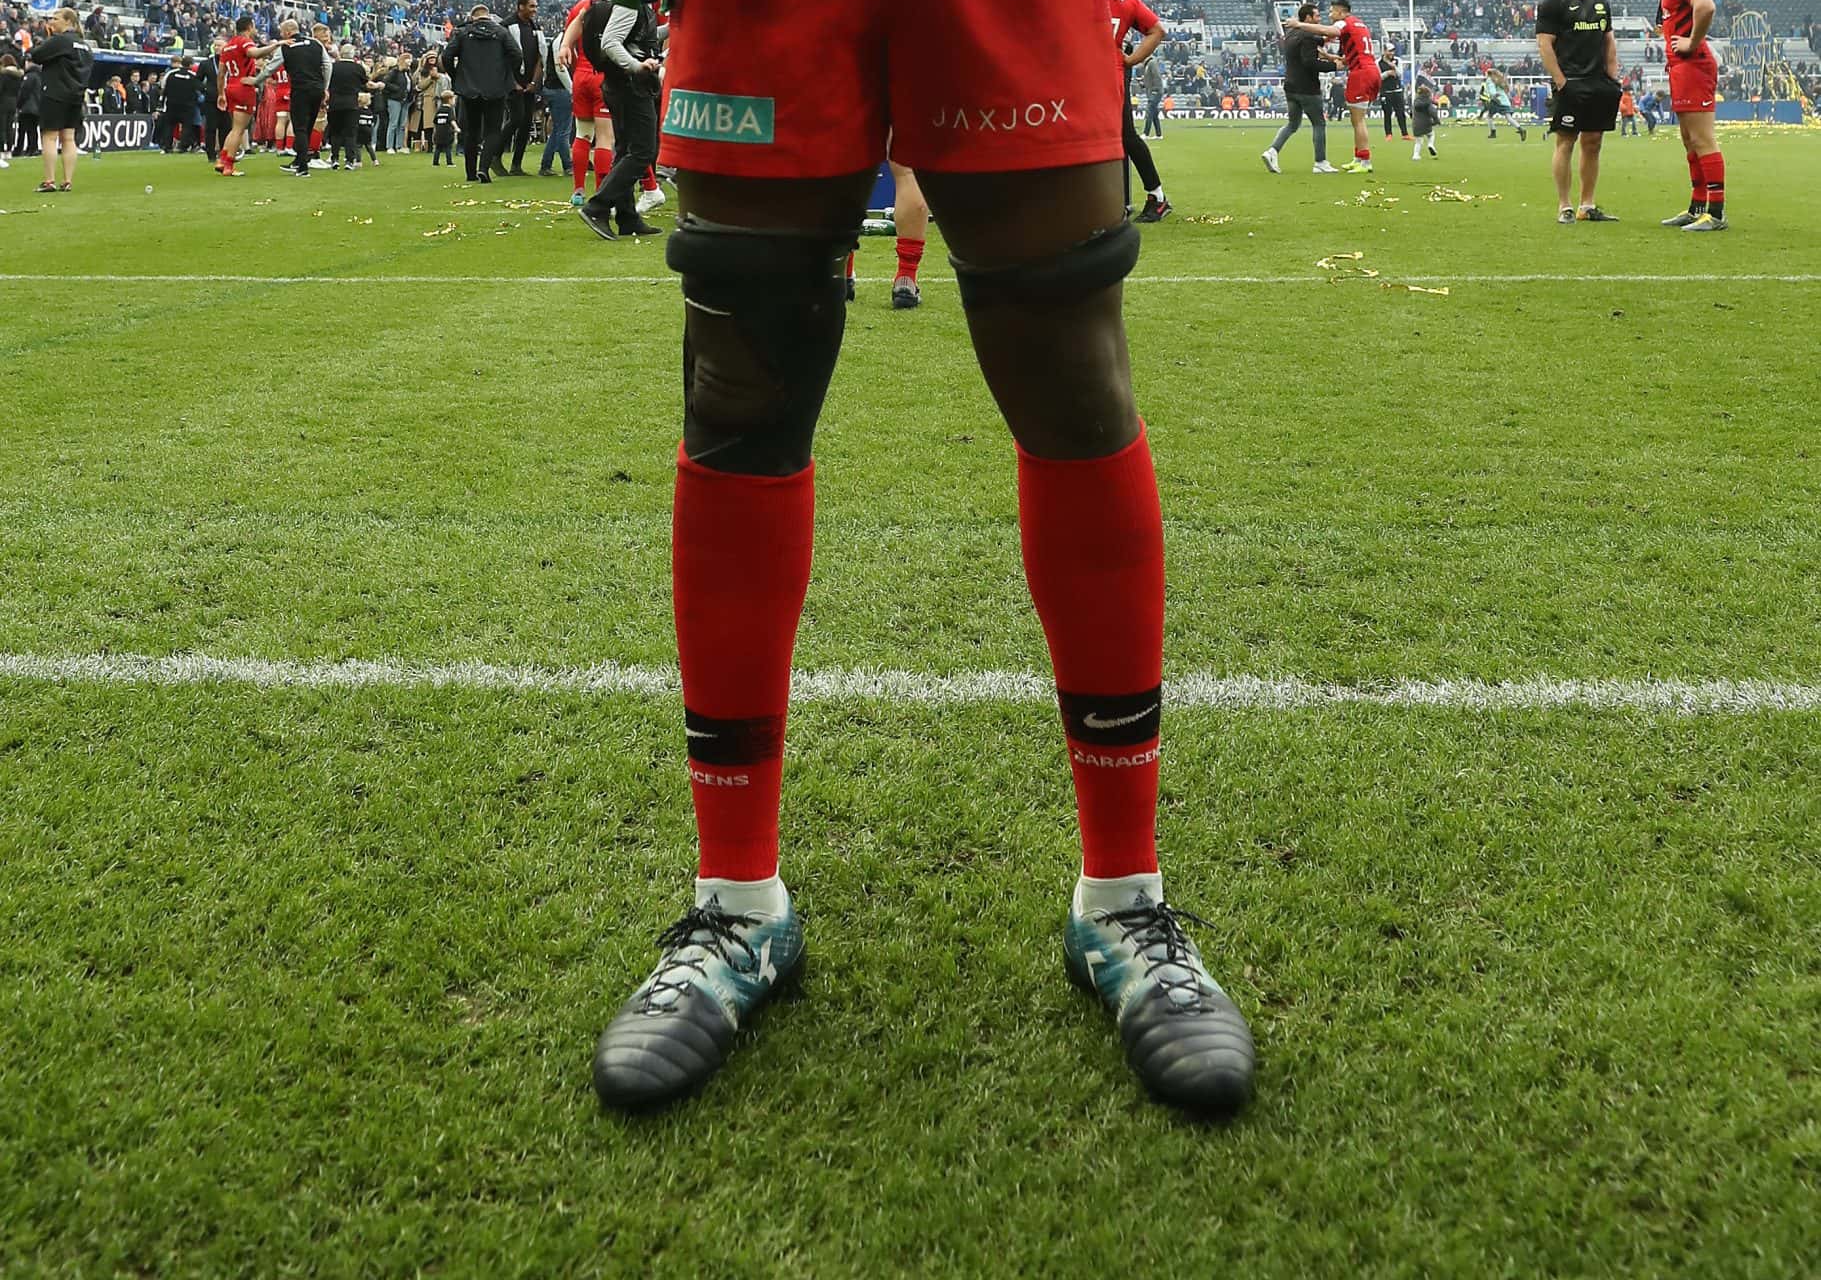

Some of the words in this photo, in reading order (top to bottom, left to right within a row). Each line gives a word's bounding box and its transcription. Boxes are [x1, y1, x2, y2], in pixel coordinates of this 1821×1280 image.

[1573, 21, 1600, 31] Allianz
[225, 60, 240, 77] 13
[671, 97, 763, 136] SIMBA
[932, 98, 1068, 132] JAXJOX
[1210, 110, 1250, 120] 2019
[114, 120, 148, 148] CUP
